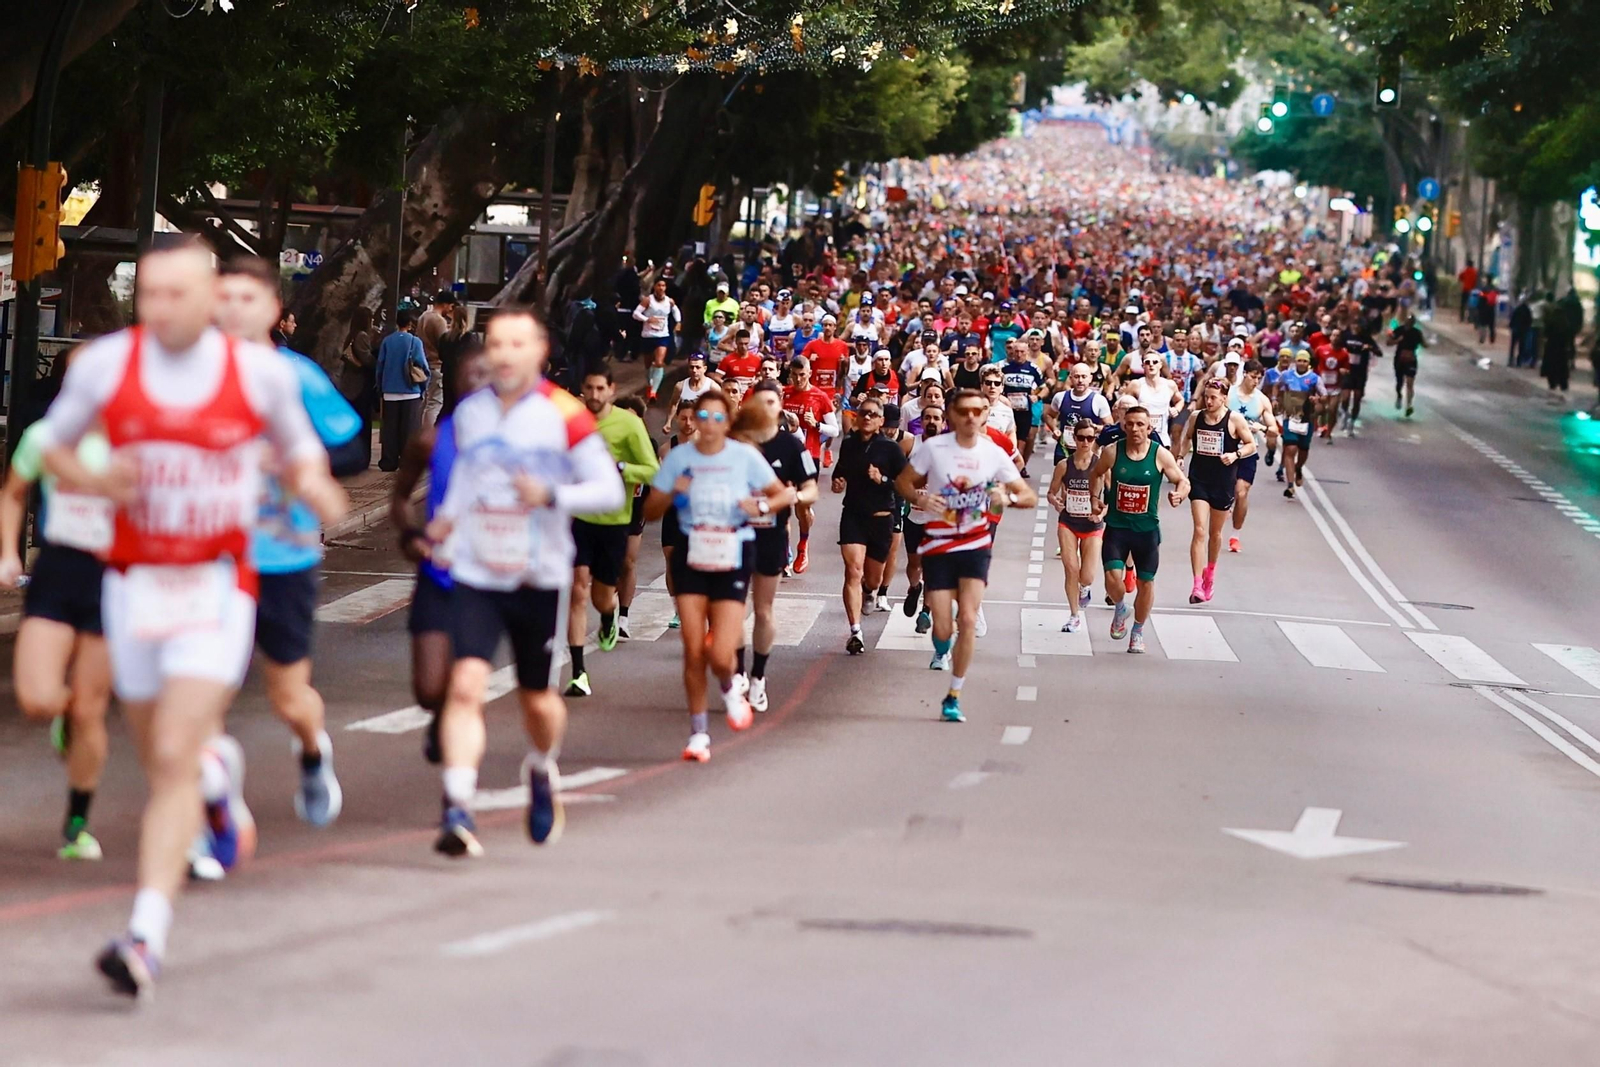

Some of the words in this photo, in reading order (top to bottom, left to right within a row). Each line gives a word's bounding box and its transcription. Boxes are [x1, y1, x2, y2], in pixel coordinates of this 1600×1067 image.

[284, 251, 299, 263] 21
[304, 253, 323, 266] N4
[1006, 375, 1030, 385] orbix
[1124, 491, 1140, 499] 6639
